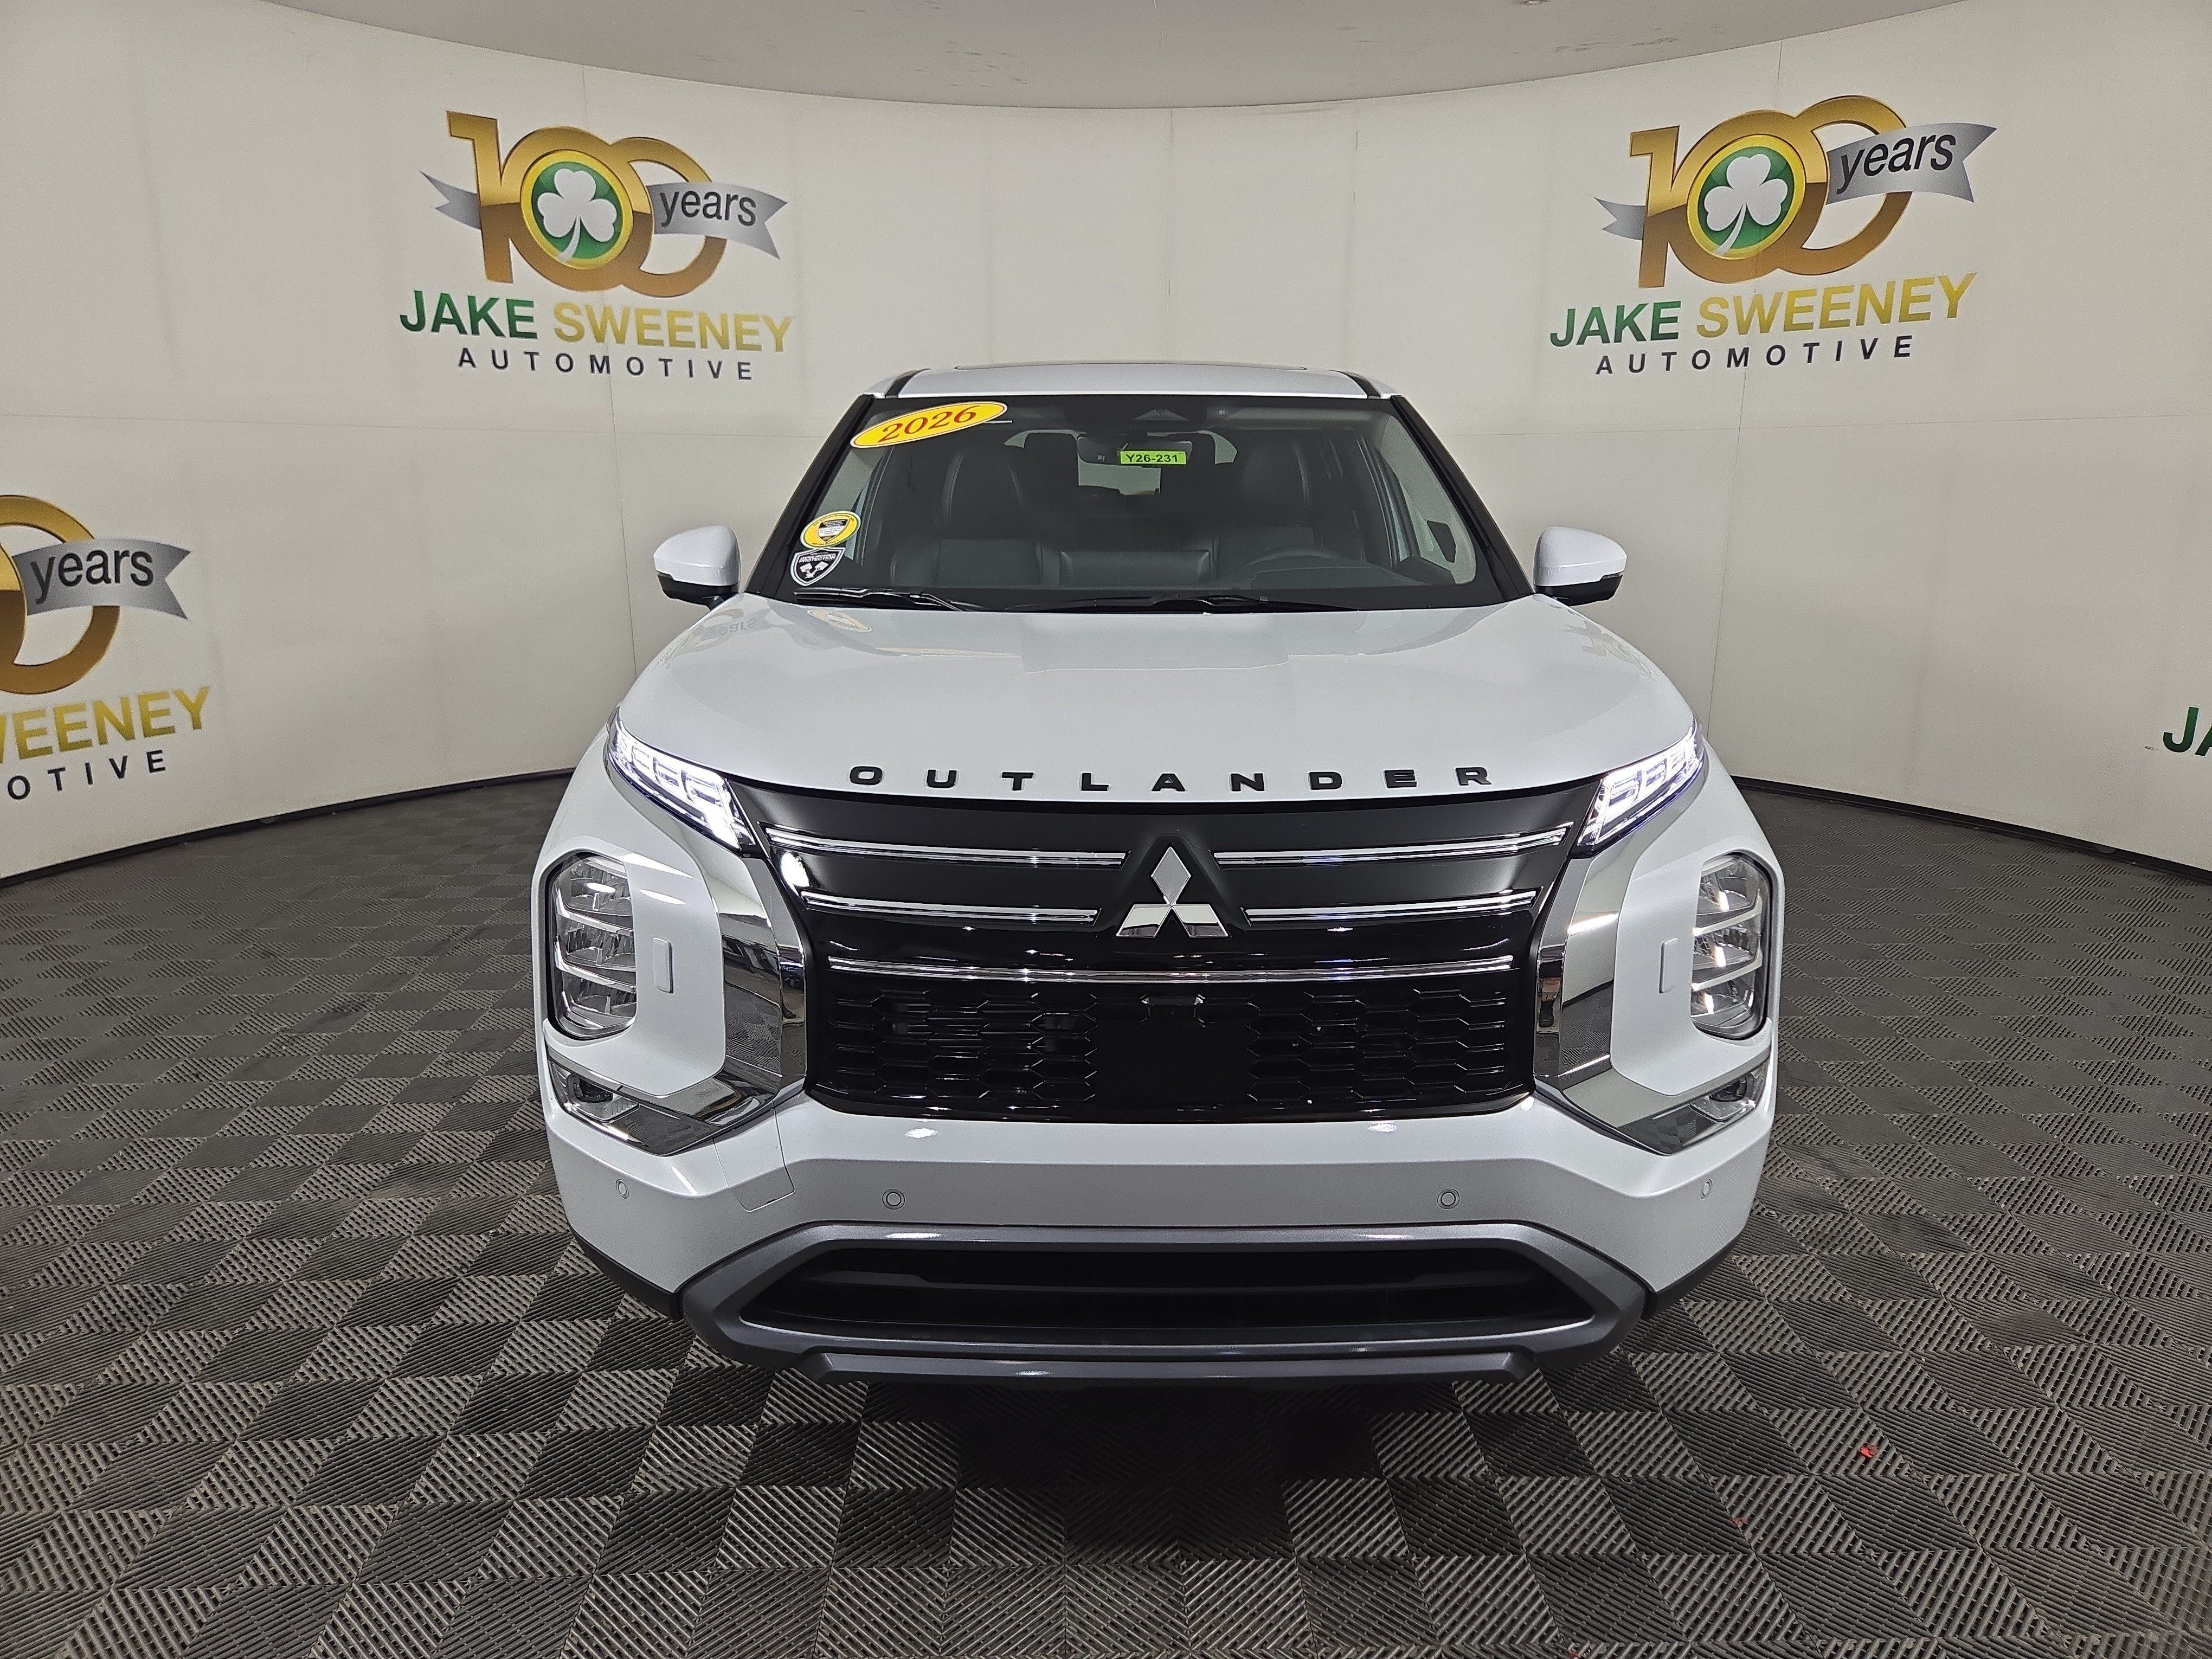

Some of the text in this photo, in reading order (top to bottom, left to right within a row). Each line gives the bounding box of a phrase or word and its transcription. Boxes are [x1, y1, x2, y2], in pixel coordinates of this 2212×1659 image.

[446, 110, 757, 298] 100 years
[1630, 95, 1956, 289] 100 years
[400, 290, 793, 352] JAKE SWEENEY
[1549, 272, 1978, 348] JAKE SWEENEY
[458, 348, 753, 380] AUTOMOTIVE
[1596, 335, 1913, 375] AUTOMOTIVE
[877, 405, 980, 443] 2026
[1126, 454, 1178, 462] Y26-231
[30, 550, 153, 605] years
[0, 686, 210, 763] EENEY
[849, 765, 1492, 792] OUTLANDER
